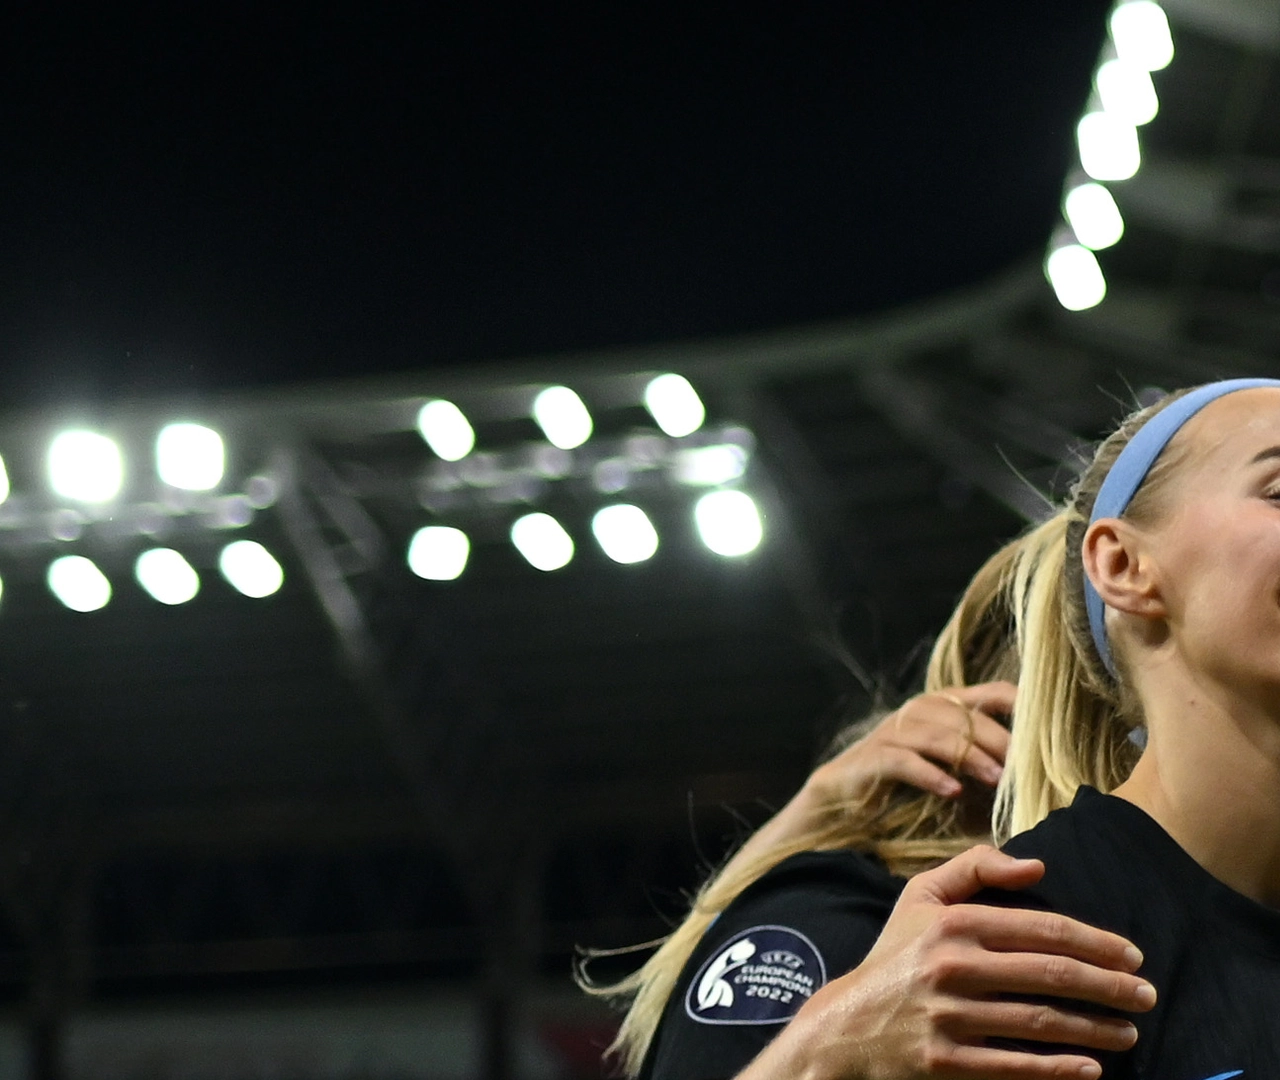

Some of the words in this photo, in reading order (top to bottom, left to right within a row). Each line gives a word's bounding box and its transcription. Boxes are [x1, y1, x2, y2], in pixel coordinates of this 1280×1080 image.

[760, 950, 805, 969] UEFA
[733, 974, 812, 997] CHAMPIONS
[741, 965, 813, 986] EUROPEAN
[746, 985, 793, 1003] 2022
